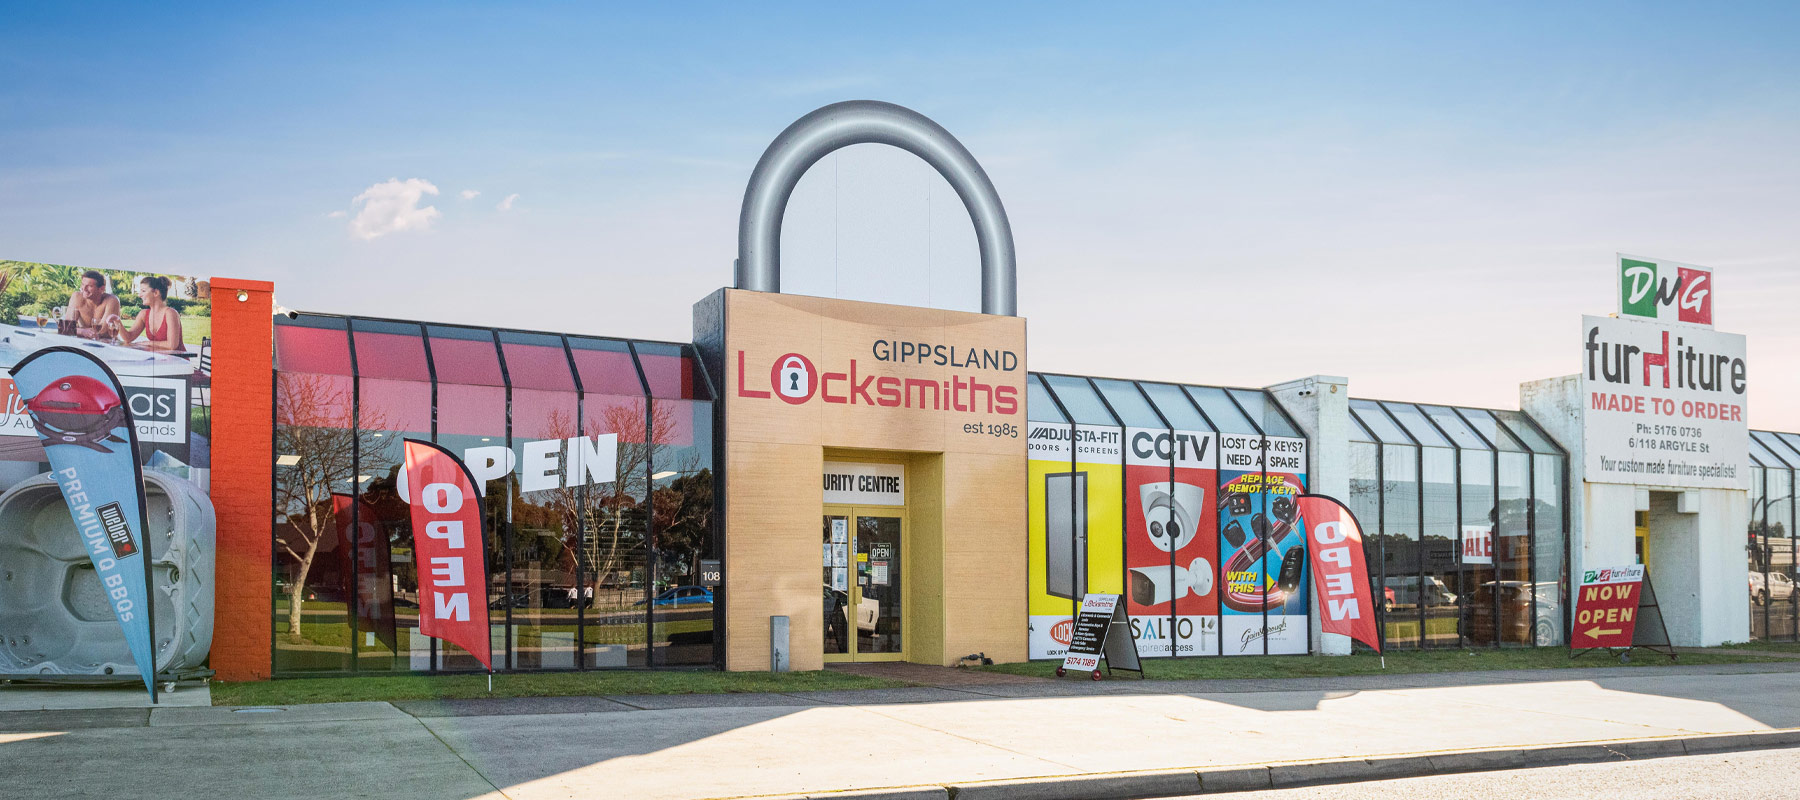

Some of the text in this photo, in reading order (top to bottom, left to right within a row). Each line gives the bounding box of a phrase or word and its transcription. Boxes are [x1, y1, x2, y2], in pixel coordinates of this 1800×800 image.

[872, 339, 1018, 372] GIPPSLAND
[1592, 391, 1742, 422] MADE TO ORDER
[963, 422, 1018, 438] est 1985
[1636, 423, 1702, 438] Ph: 5176 0736
[1028, 443, 1060, 452] DOORS
[1078, 446, 1119, 455] SCREENS
[1131, 431, 1210, 462] CCTV
[1221, 437, 1303, 453] LOST CAR KEYS?
[1628, 437, 1710, 453] 6/118 ARGYLE St
[1226, 454, 1252, 466] NEED
[1270, 456, 1299, 468] SPARE
[1600, 455, 1737, 480] Your custom made furniture specialists!
[823, 473, 900, 493] URITY CENTRE
[1271, 486, 1297, 495] KEYS
[101, 506, 130, 544] weber
[58, 467, 134, 623] PREMIUM Q BBQs
[1462, 531, 1492, 557] ALE
[871, 548, 890, 557] OPEN
[702, 571, 721, 582] 108
[1226, 571, 1257, 582] WITH
[1229, 583, 1255, 593] THIS
[1585, 584, 1633, 602] NOW
[1578, 607, 1633, 625] OPEN
[1131, 617, 1193, 640] SALTO
[1066, 656, 1096, 667] 5174 1189
